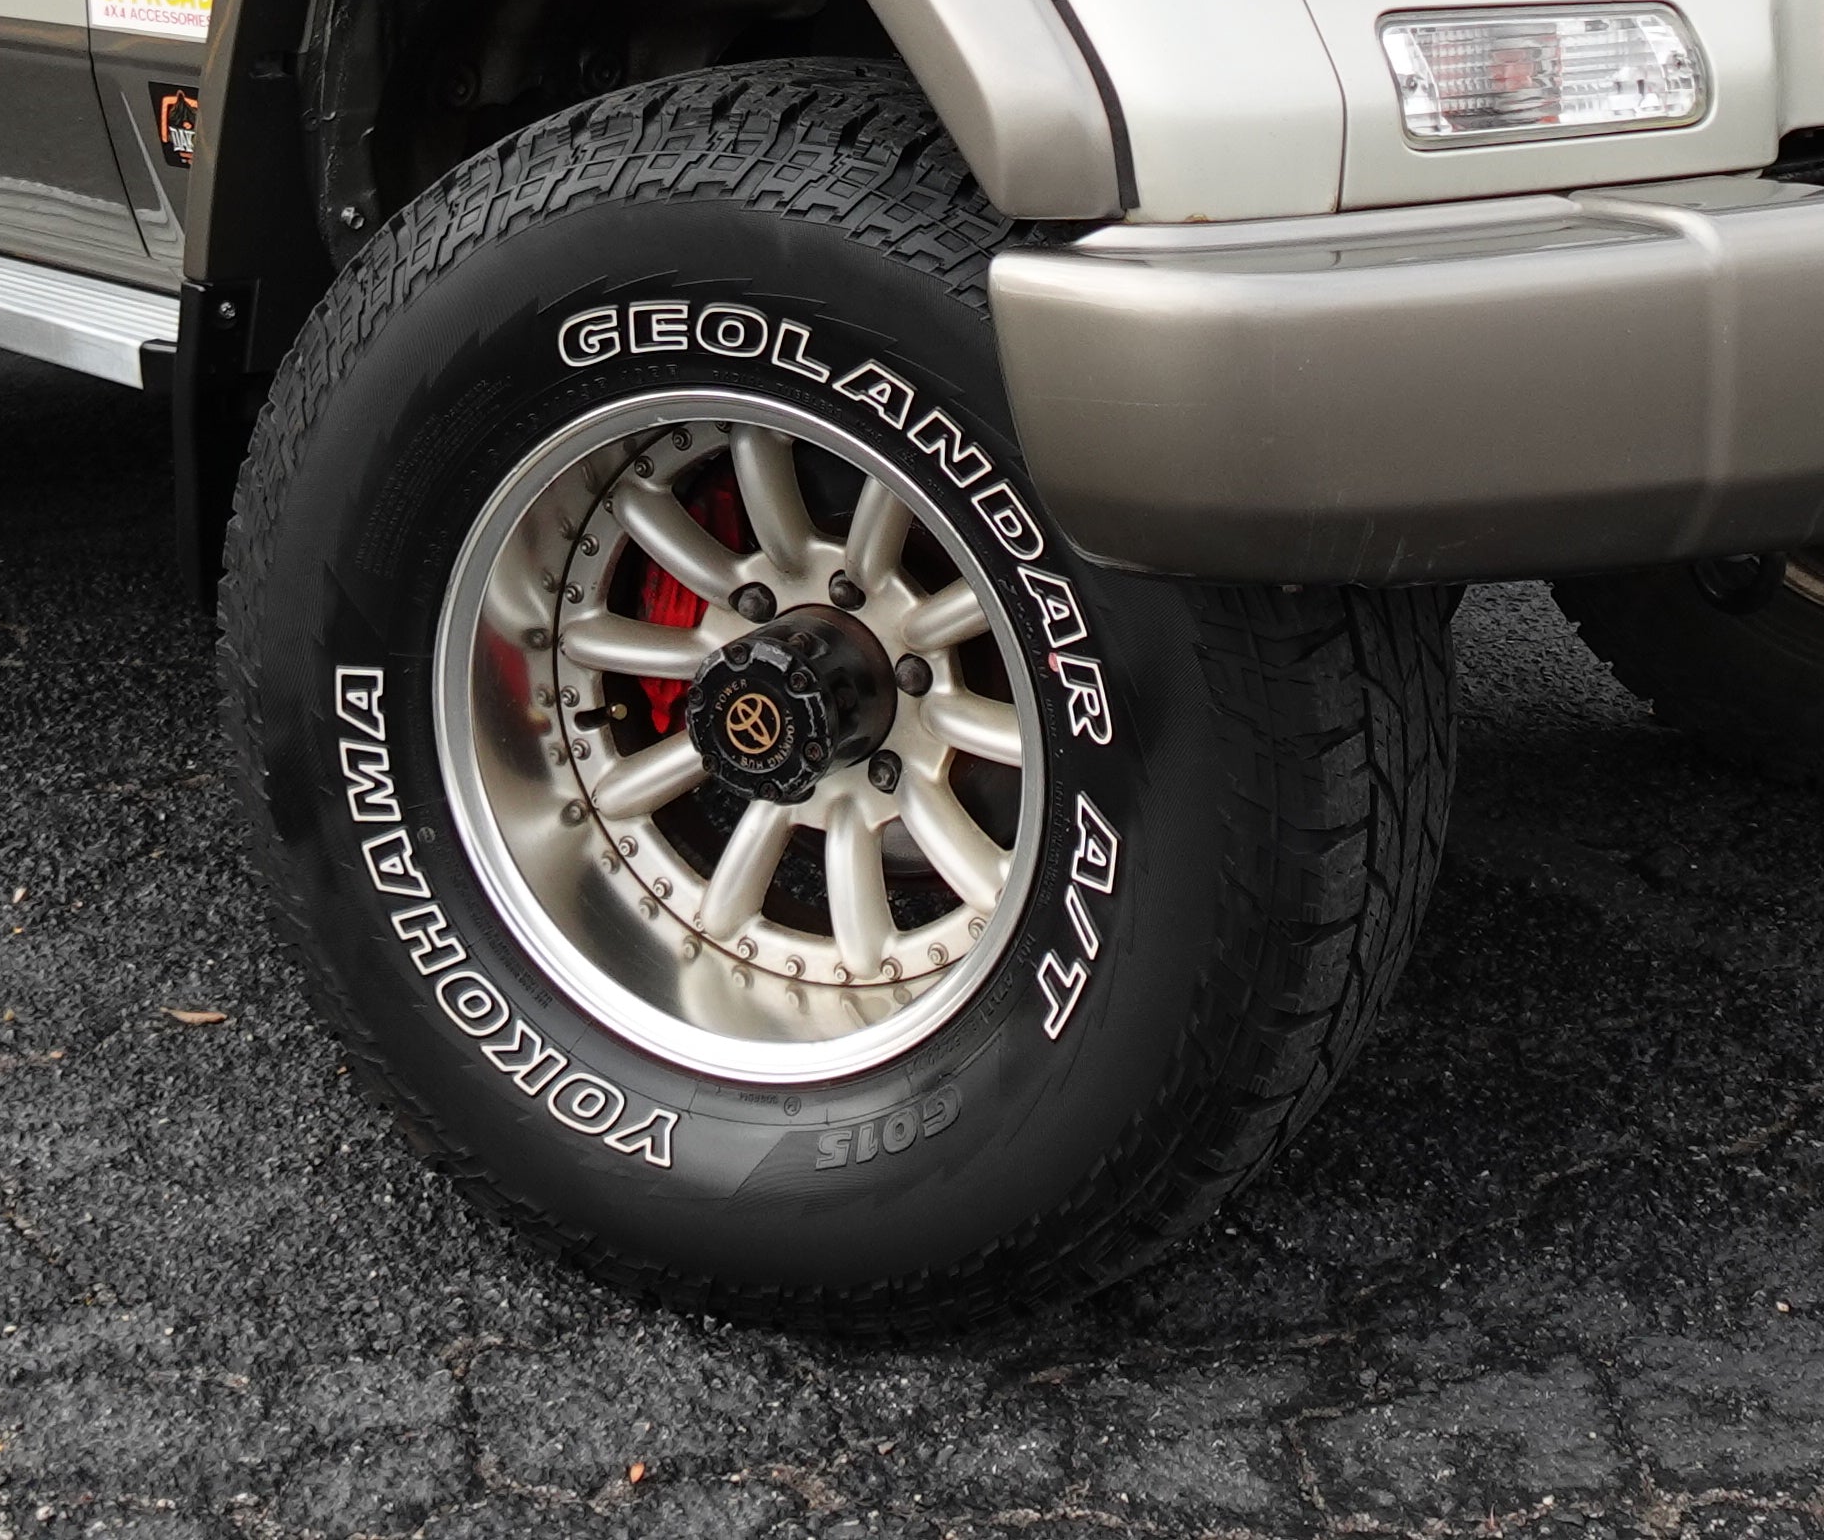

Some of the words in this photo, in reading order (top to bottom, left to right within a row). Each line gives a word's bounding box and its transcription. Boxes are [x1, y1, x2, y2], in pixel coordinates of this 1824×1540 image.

[130, 8, 212, 28] ACCESSORIES
[557, 301, 1114, 748] GEOLANDAR
[1036, 791, 1118, 1041] A/T
[715, 678, 748, 711] POWER
[335, 664, 679, 1168] YOKOHAMA
[815, 1083, 963, 1171] G015
